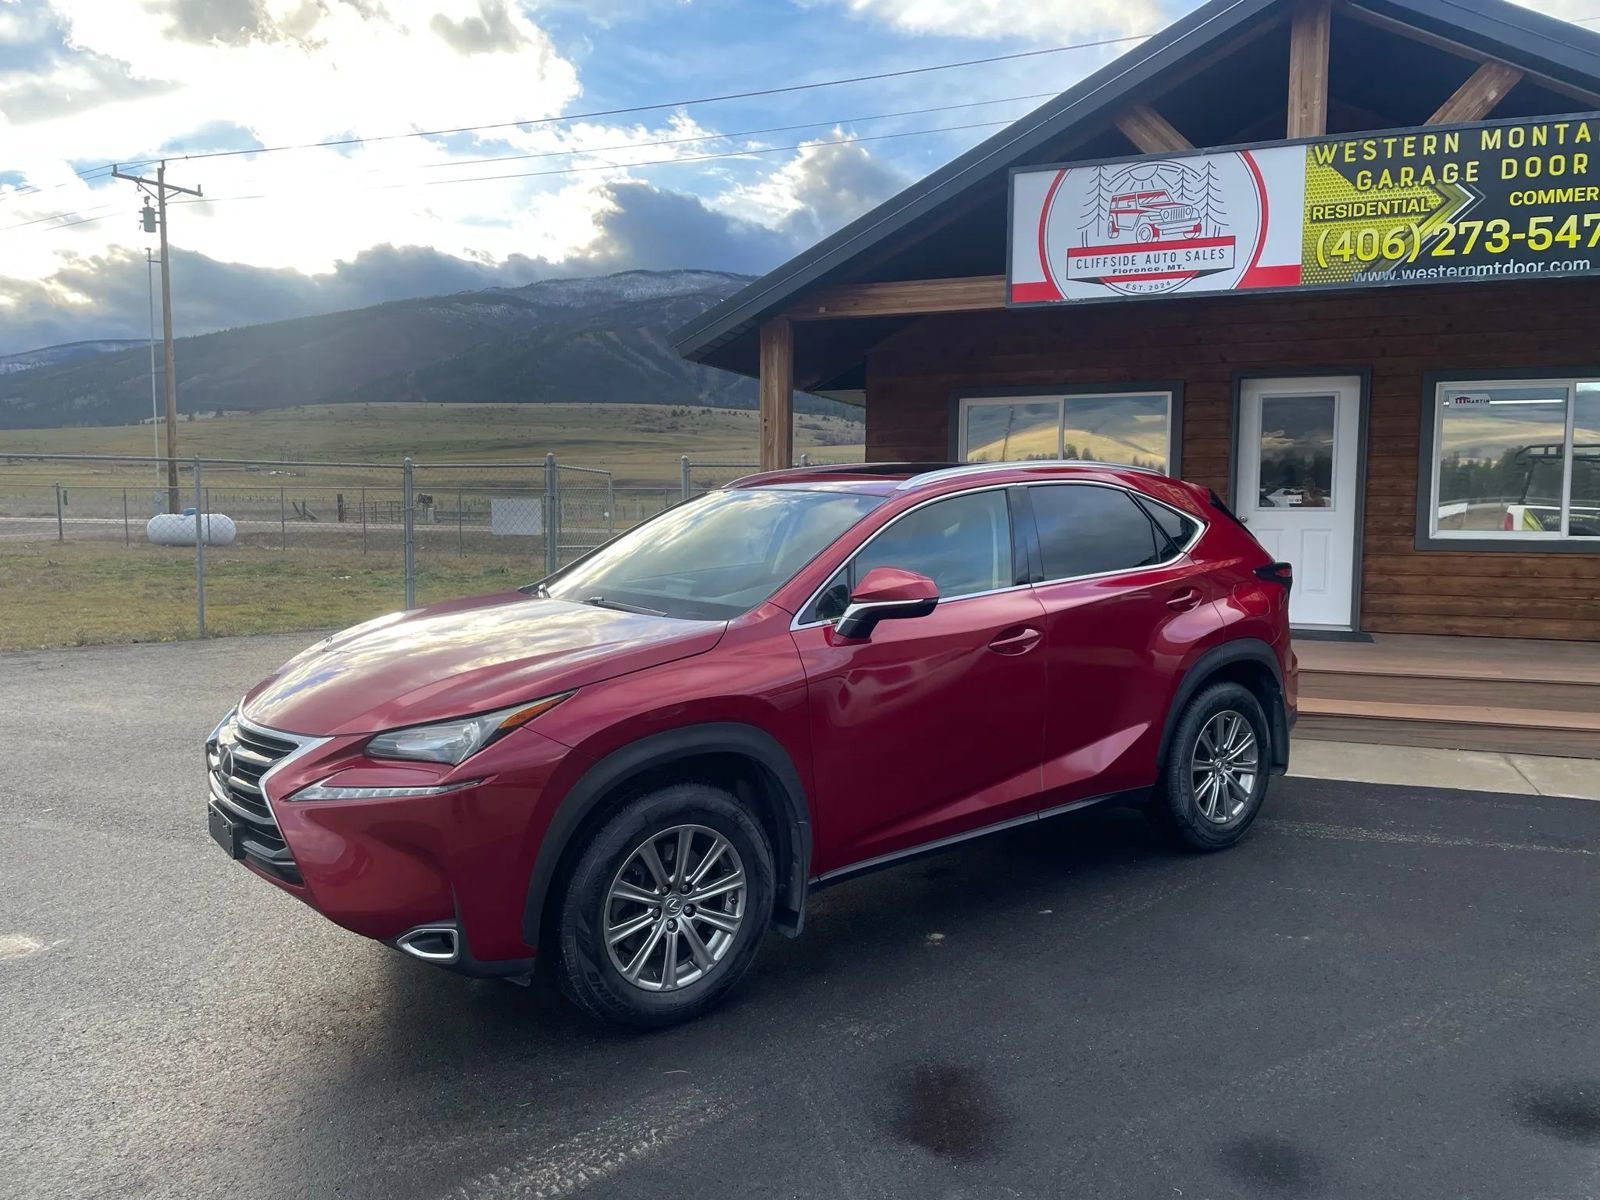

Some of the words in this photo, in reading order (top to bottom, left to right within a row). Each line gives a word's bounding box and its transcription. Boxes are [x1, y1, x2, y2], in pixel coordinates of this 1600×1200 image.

[1314, 132, 1460, 165] WESTERN
[1481, 121, 1600, 151] MONTA
[1356, 160, 1480, 191] GARAGE
[1501, 153, 1589, 180] DOOR
[1311, 198, 1431, 221] RESIDENTIAL
[1509, 186, 1600, 206] COMMER
[1076, 254, 1137, 270] CLIFFSIDE
[1145, 252, 1177, 265] AUTO
[1185, 248, 1225, 262] SALES
[1316, 222, 1421, 268] (406)
[1112, 265, 1164, 275] Florence,
[1167, 263, 1185, 271] MT.
[1353, 258, 1590, 282] www.westernmtdoor.com
[1125, 283, 1146, 291] EST.
[1149, 280, 1171, 291] 2024
